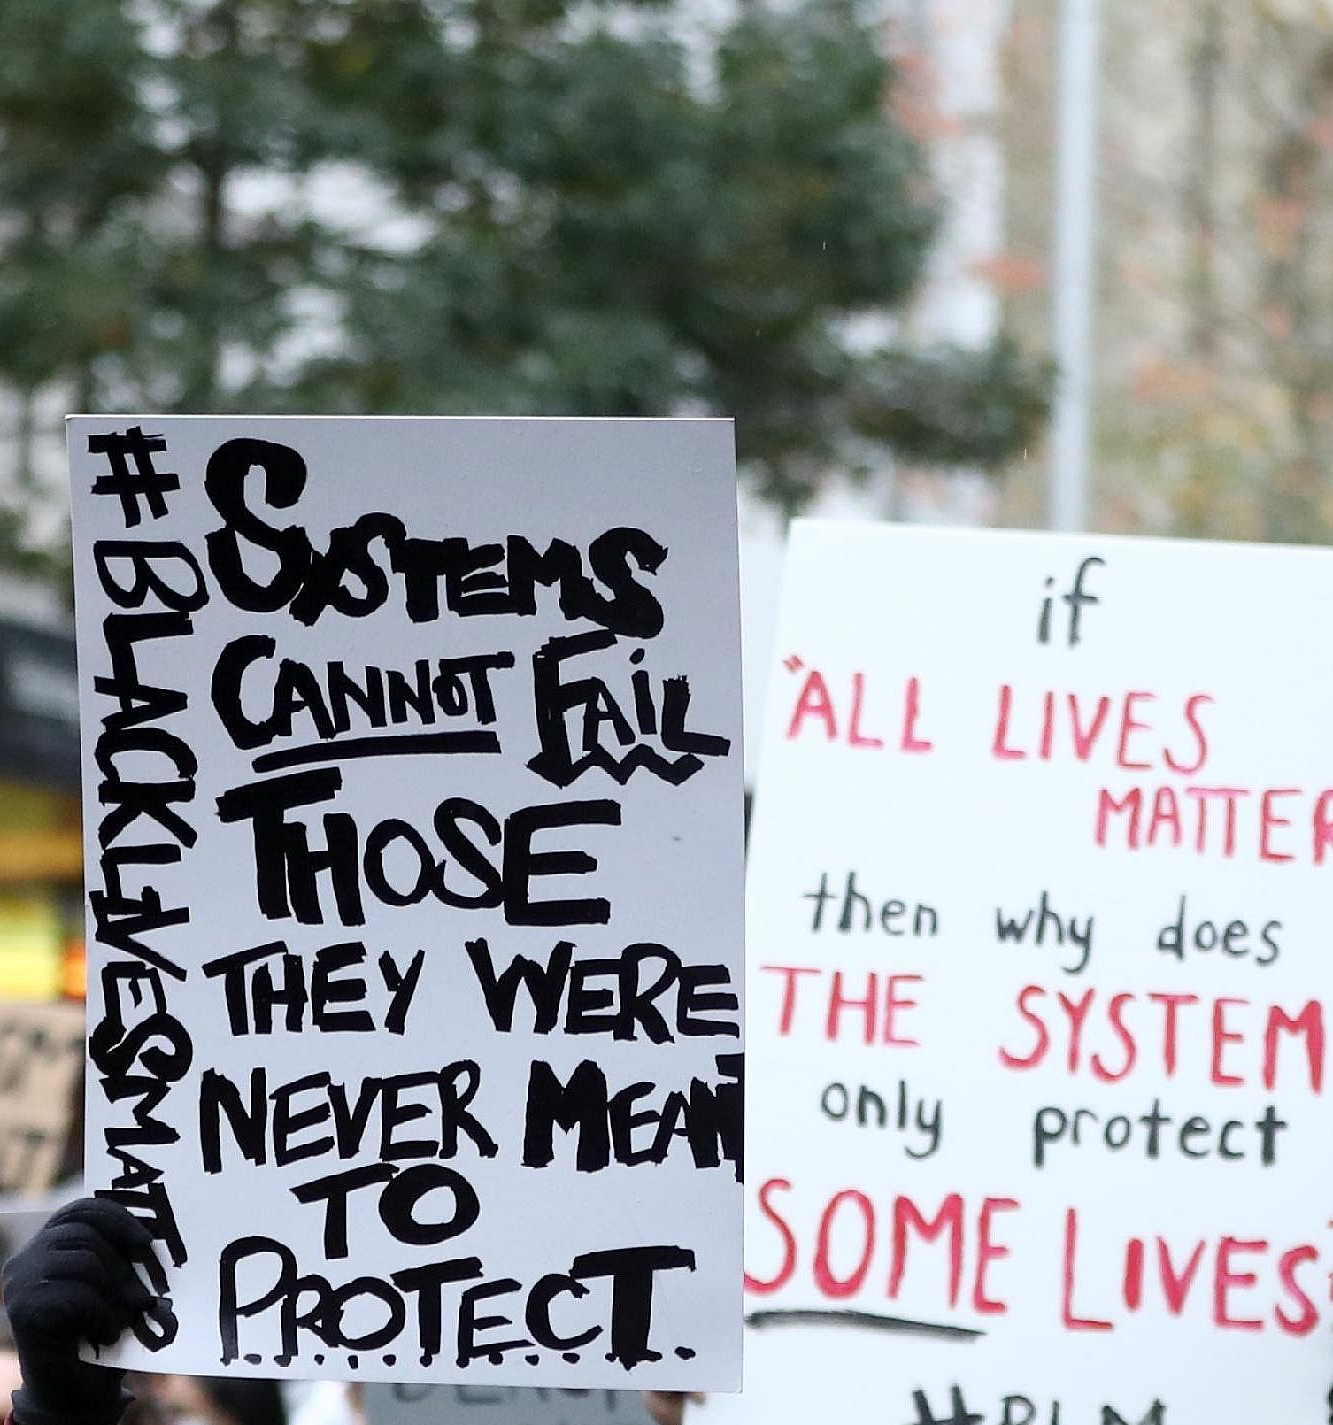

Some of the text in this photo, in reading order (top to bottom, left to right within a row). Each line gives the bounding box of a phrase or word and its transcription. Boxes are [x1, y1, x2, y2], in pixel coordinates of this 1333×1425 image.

[1036, 557, 1107, 647] if
[211, 634, 515, 752] CANNOT
[991, 684, 1217, 776] LIVES
[216, 766, 622, 927] THOSE
[803, 871, 1284, 976] then why does
[203, 937, 741, 1044] THEY WERE
[759, 965, 925, 1048] THE
[997, 985, 1328, 1096] SYSTEM
[199, 1059, 499, 1174] NEVER
[820, 1079, 1289, 1170] only protect
[289, 1162, 481, 1260] TO
[743, 1176, 1021, 1316] SOME
